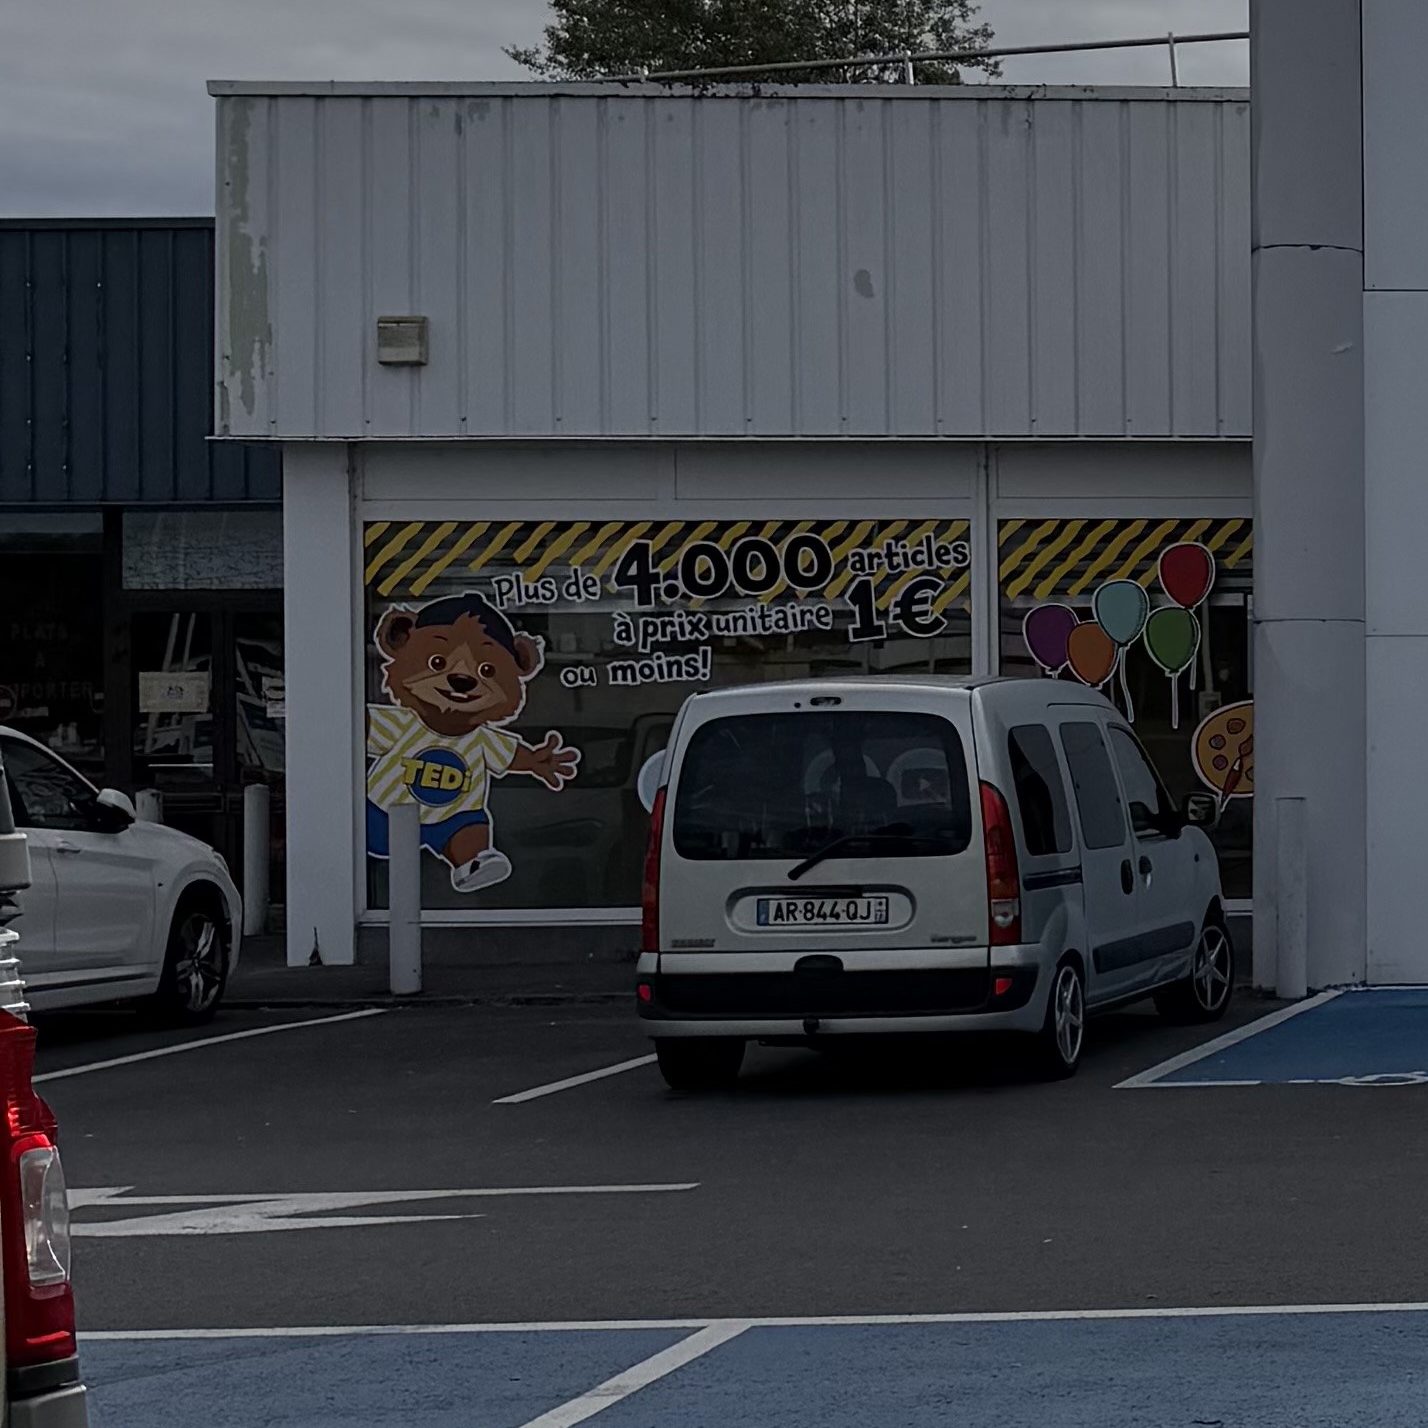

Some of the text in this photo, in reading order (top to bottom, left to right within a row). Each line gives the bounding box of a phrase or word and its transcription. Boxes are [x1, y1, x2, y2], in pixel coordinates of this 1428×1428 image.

[496, 534, 969, 608] Plus de 4.000 articles
[615, 613, 634, 644] à
[641, 615, 708, 651] prix
[715, 604, 832, 636] unitaire
[562, 647, 712, 687] ou moins!
[402, 756, 471, 793] TEDi
[773, 900, 871, 921] AR-844-QJ
